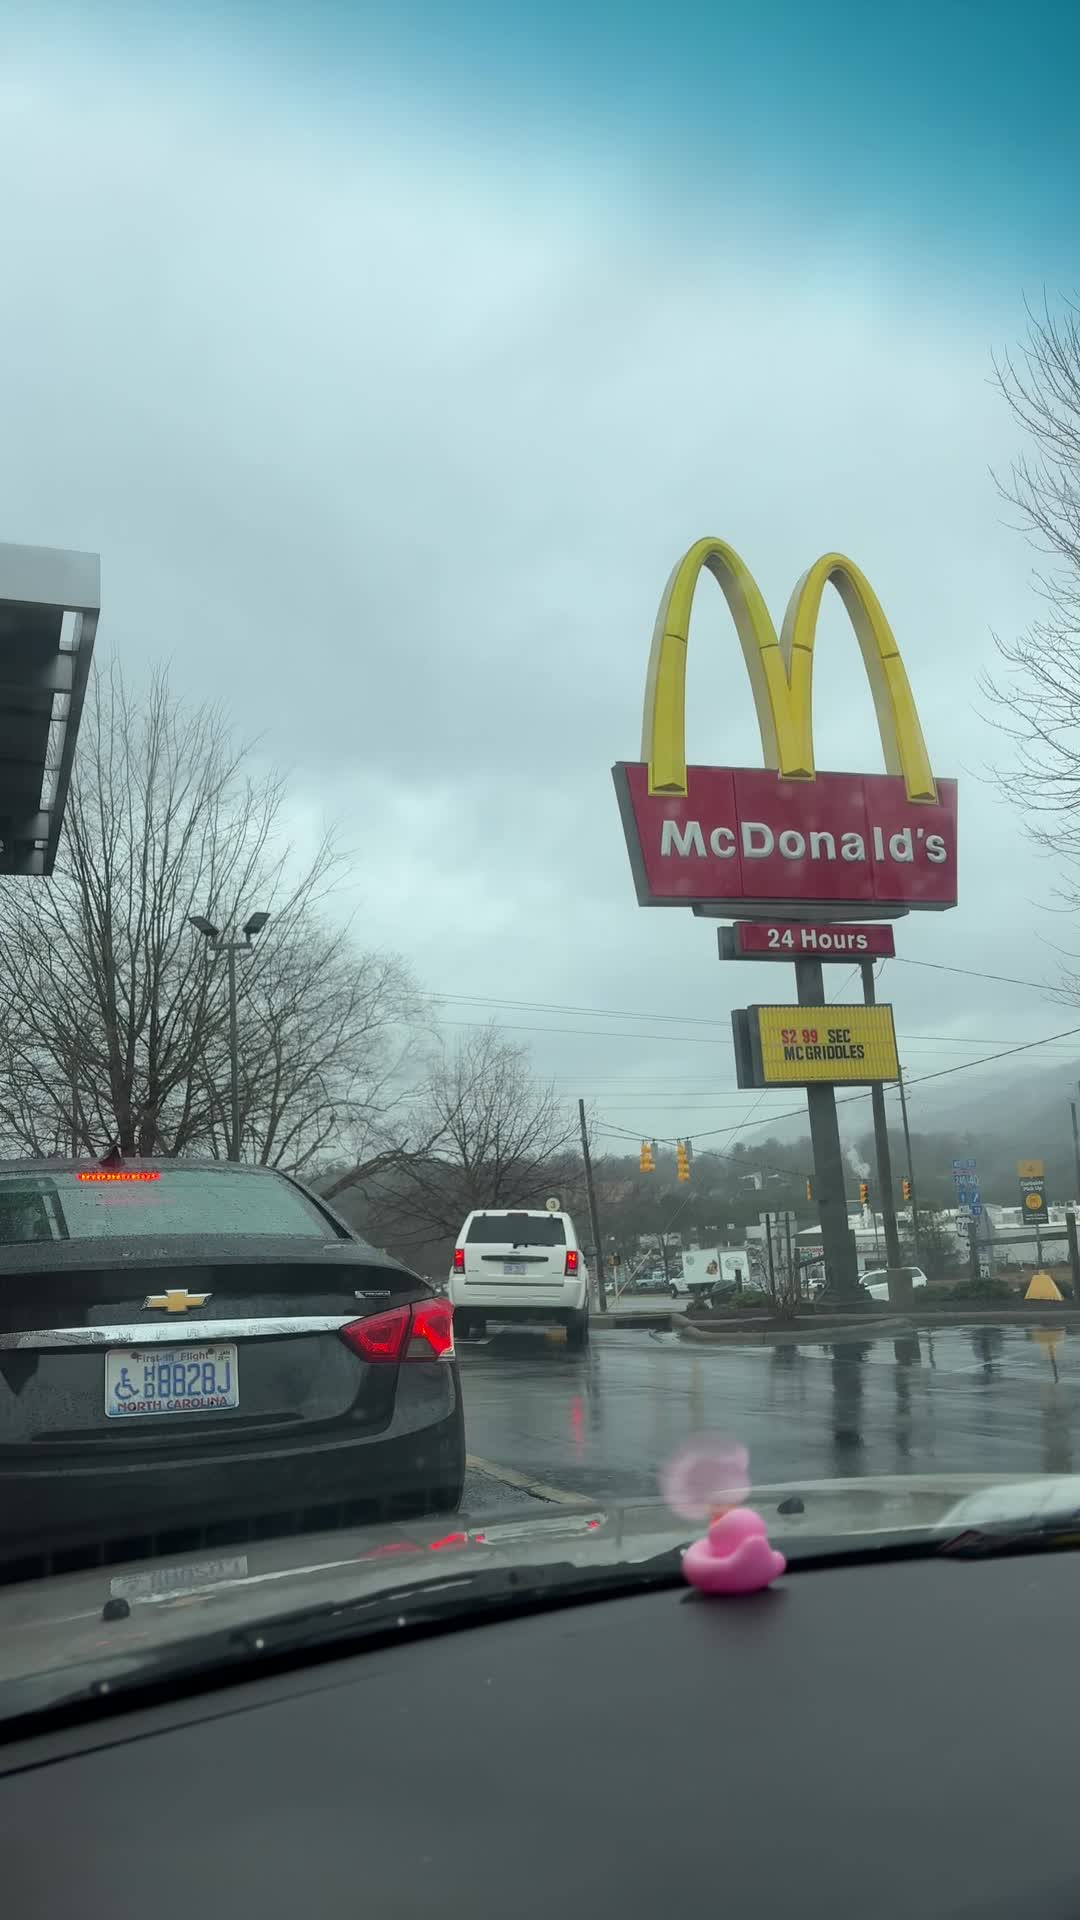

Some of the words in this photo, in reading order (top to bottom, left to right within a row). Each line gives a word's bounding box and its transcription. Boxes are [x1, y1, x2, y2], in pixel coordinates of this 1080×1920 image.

[660, 820, 948, 863] McDonald's
[767, 928, 794, 948] 24
[801, 929, 868, 949] Hours
[827, 1029, 851, 1043] SEC
[784, 1045, 864, 1060] MCGRIDDLES
[136, 1354, 160, 1362] First
[181, 1350, 209, 1361] Flight
[118, 1400, 161, 1412] NORTH
[167, 1396, 228, 1409] CAROLINA
